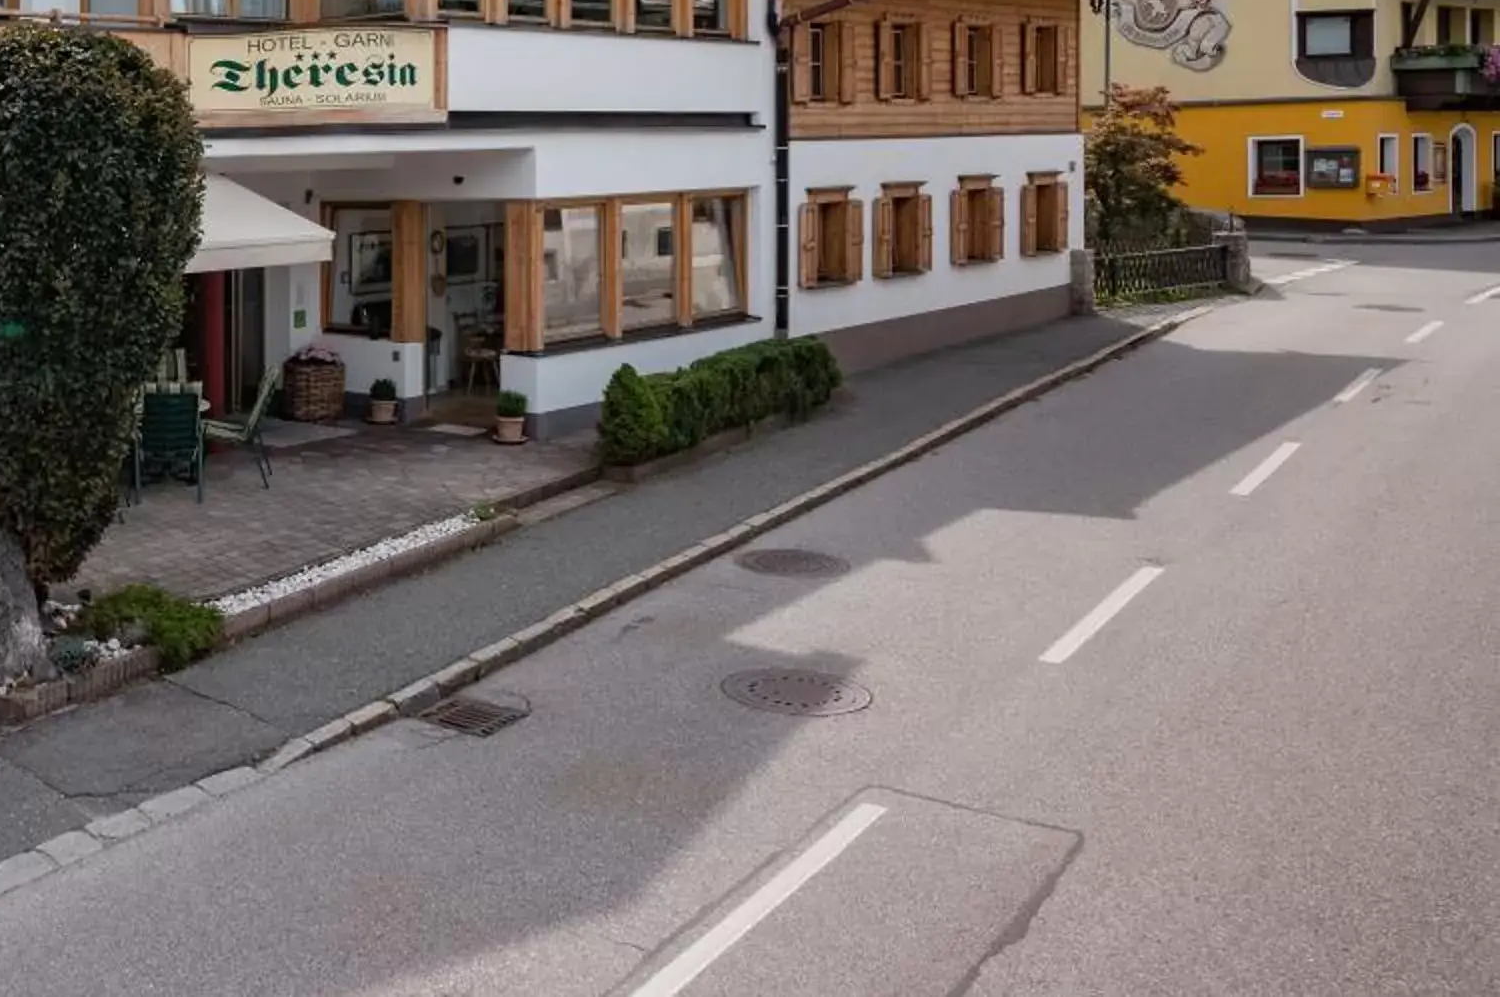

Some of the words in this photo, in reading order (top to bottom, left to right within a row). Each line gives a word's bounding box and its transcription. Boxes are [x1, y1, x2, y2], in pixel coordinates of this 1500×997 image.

[246, 36, 313, 54] HOTEL
[333, 32, 396, 49] GARNI
[209, 53, 418, 100] Theresia
[259, 93, 304, 107] SAUNA
[315, 90, 387, 105] SOLARIUM
